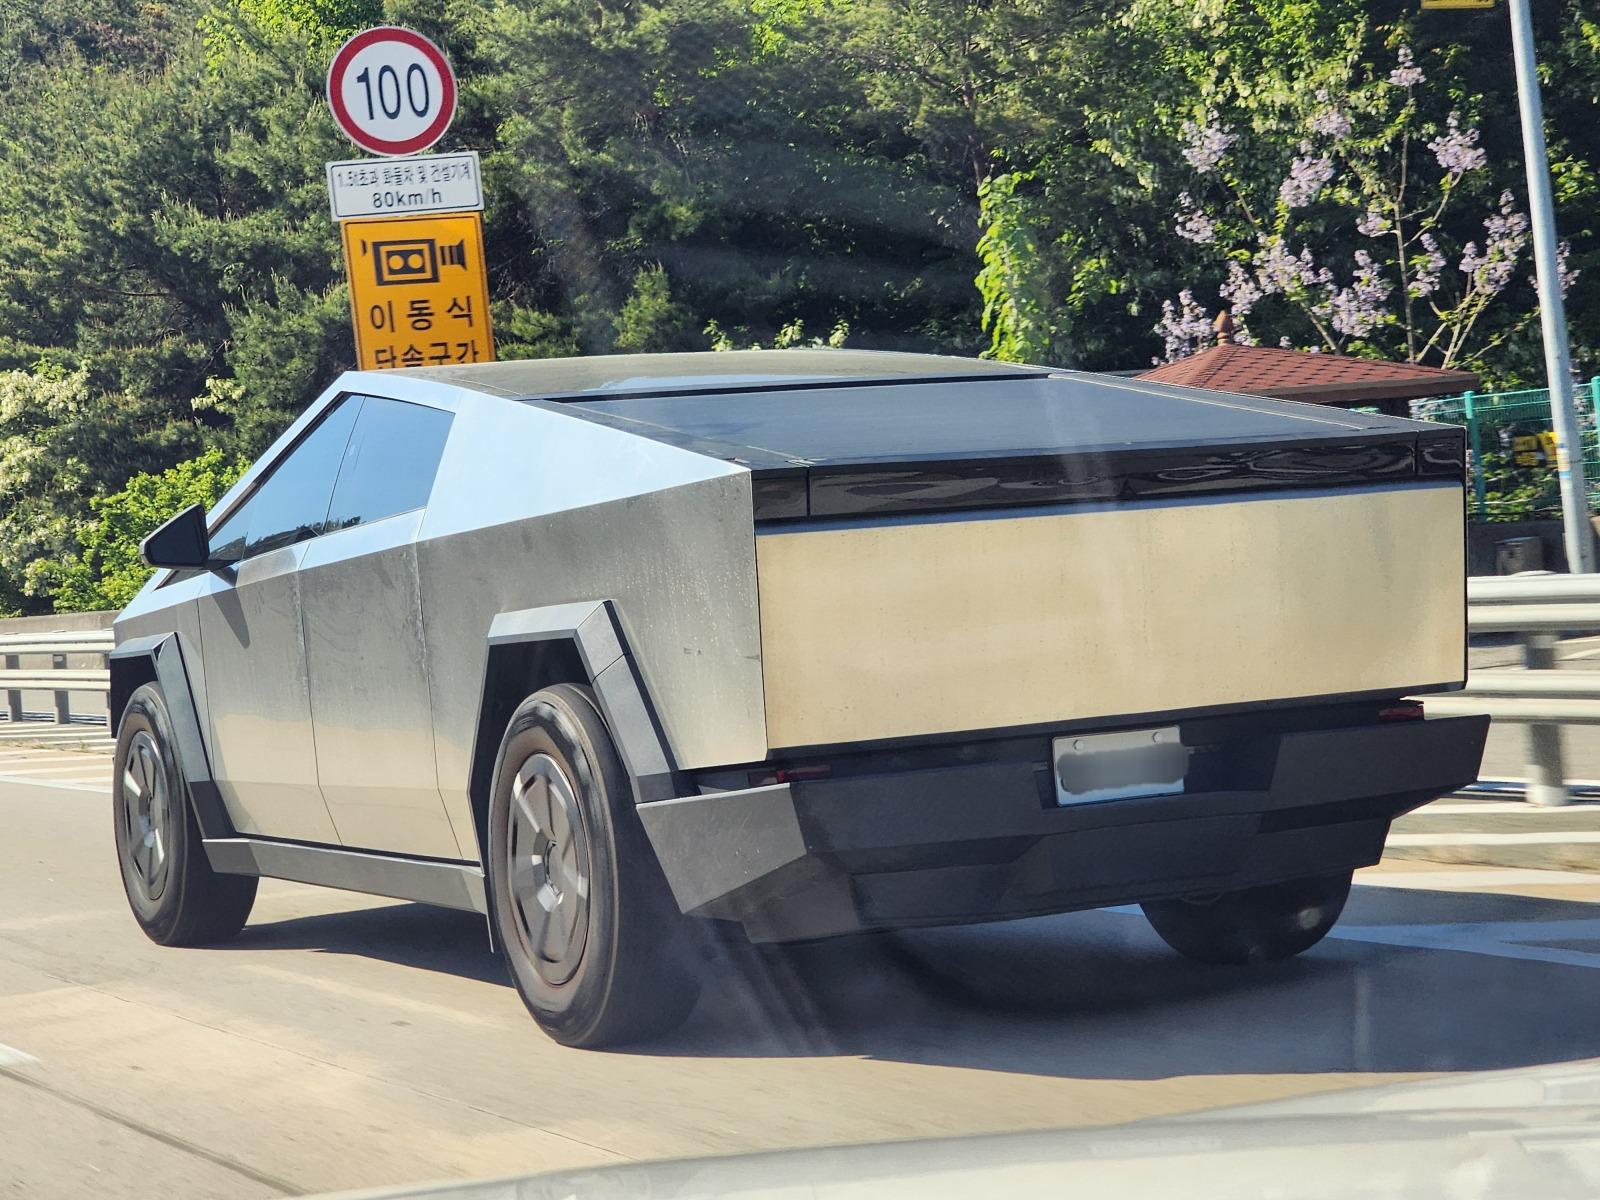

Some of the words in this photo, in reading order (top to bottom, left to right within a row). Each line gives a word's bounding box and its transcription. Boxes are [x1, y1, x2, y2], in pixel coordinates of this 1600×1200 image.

[357, 63, 429, 120] 100
[416, 164, 429, 184] 및
[372, 188, 442, 209] 80km/h
